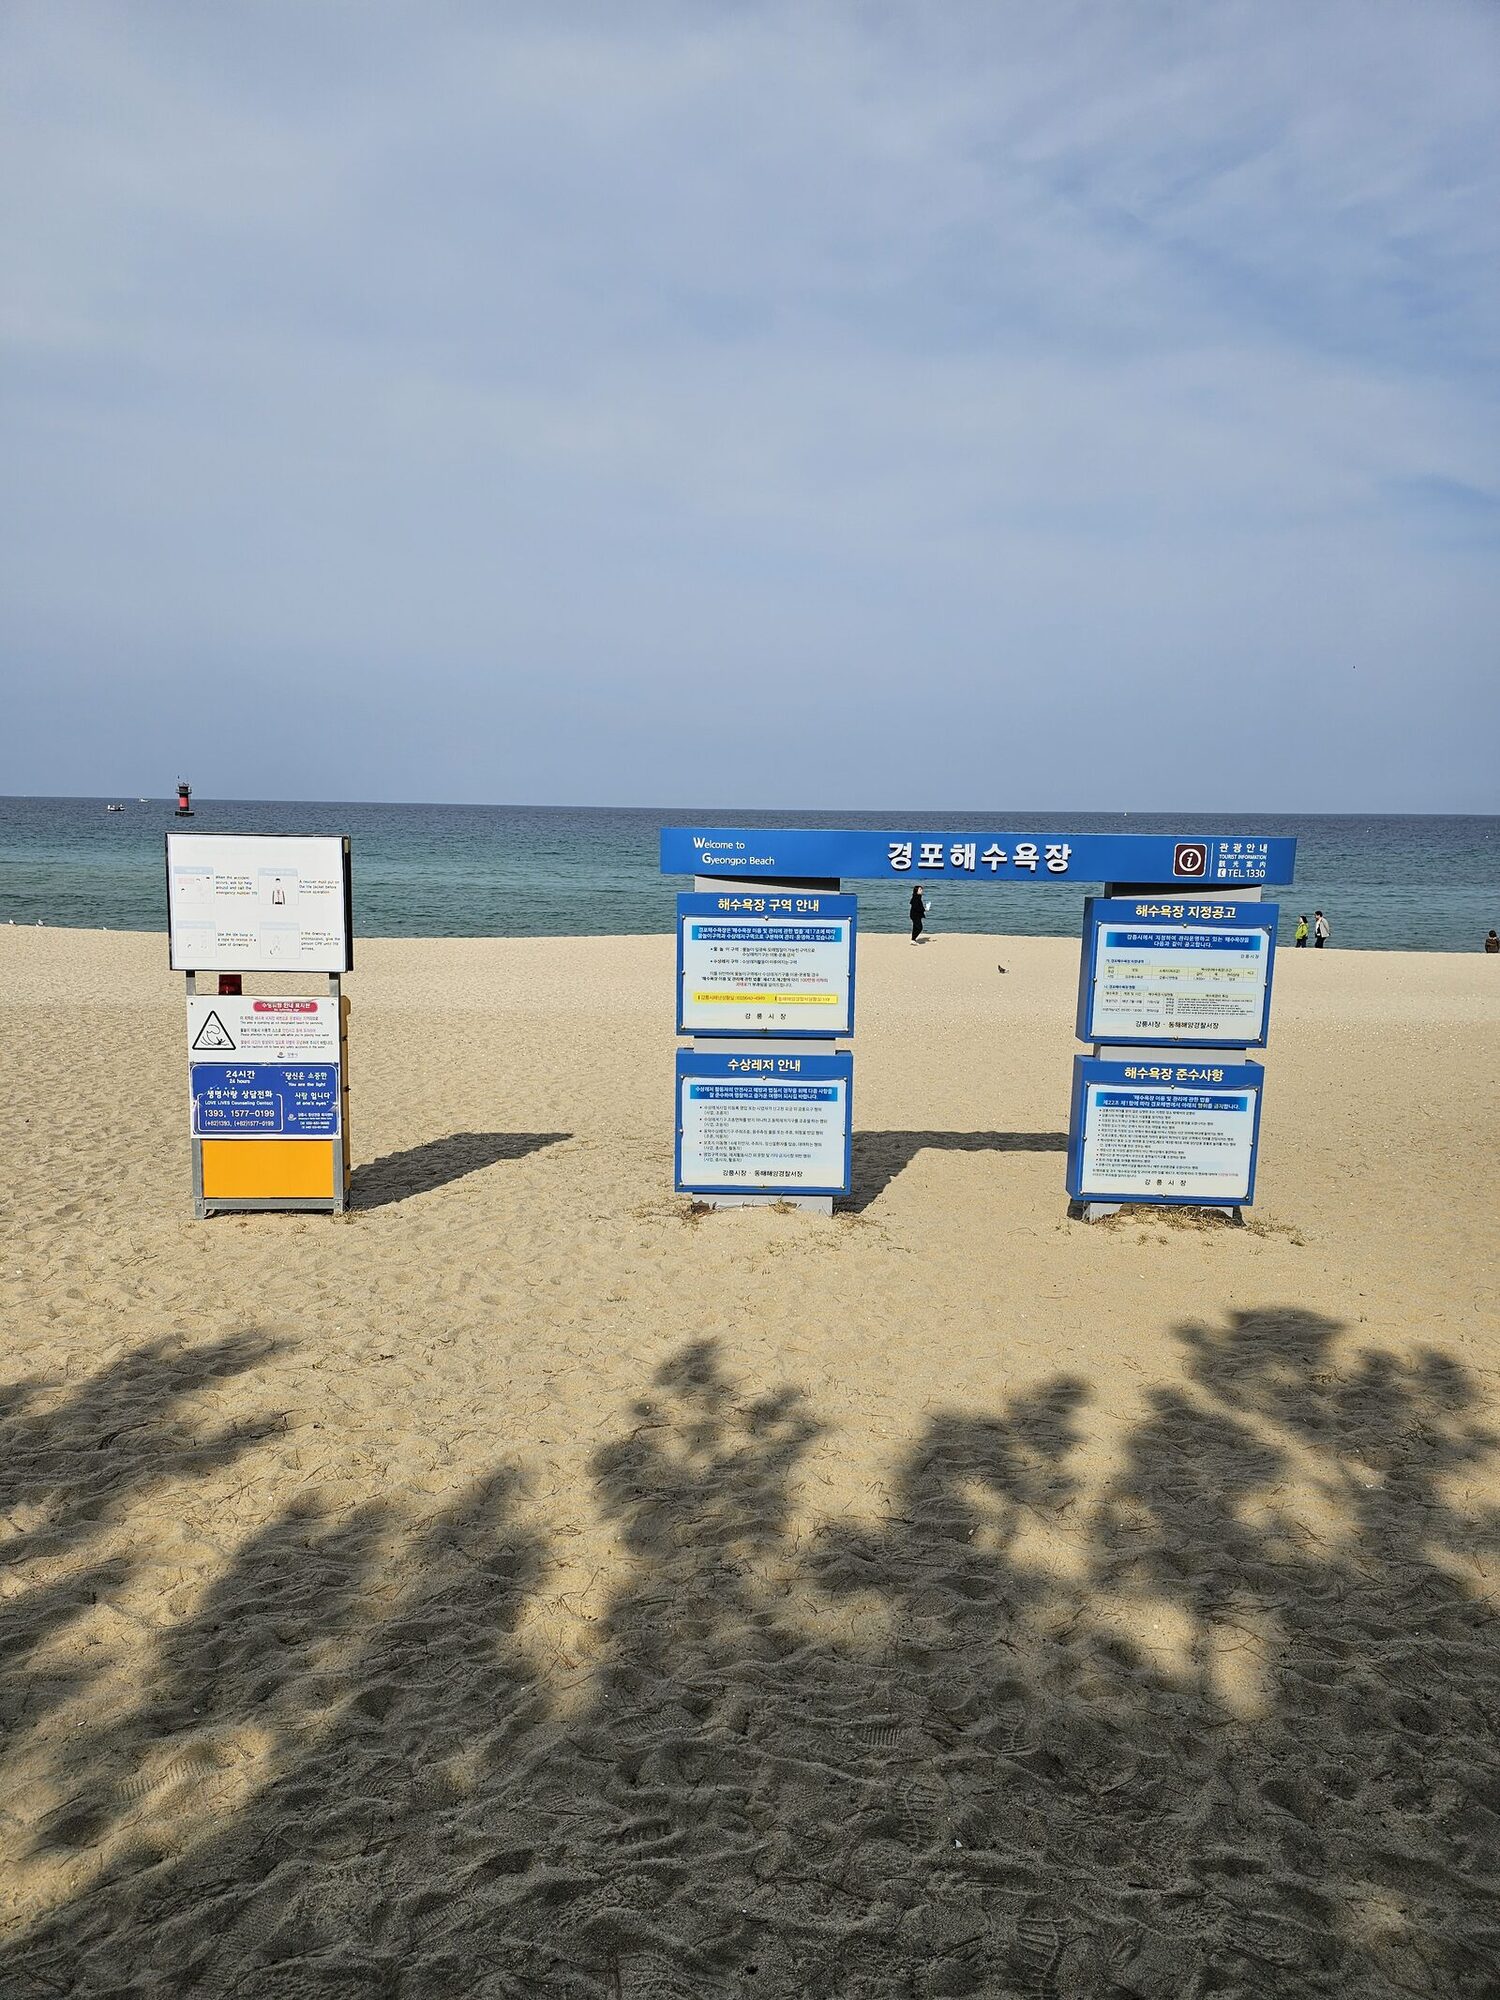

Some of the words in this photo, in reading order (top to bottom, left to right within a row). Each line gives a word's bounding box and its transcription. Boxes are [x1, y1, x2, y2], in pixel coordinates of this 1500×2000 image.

[693, 837, 733, 850] Welcome
[736, 841, 745, 850] to
[702, 852, 746, 866] Gyeongpo
[749, 856, 775, 866] Beach
[888, 843, 1072, 872] 경포해수욕장
[717, 898, 765, 912] 해수욕장
[769, 899, 792, 913] 구역
[796, 900, 820, 913] 안내
[1135, 905, 1184, 919] 해수욕장
[1187, 906, 1236, 920] 지정공고
[727, 1059, 774, 1072] 수상레저
[778, 1059, 801, 1072] 안내
[226, 1070, 256, 1080] 24시간
[307, 1072, 327, 1080] 소중한
[1124, 1067, 1173, 1080] 해수욕장
[1175, 1069, 1224, 1082] 준수사항
[207, 1090, 238, 1099] 생명사랑
[241, 1090, 273, 1099] 상담전화
